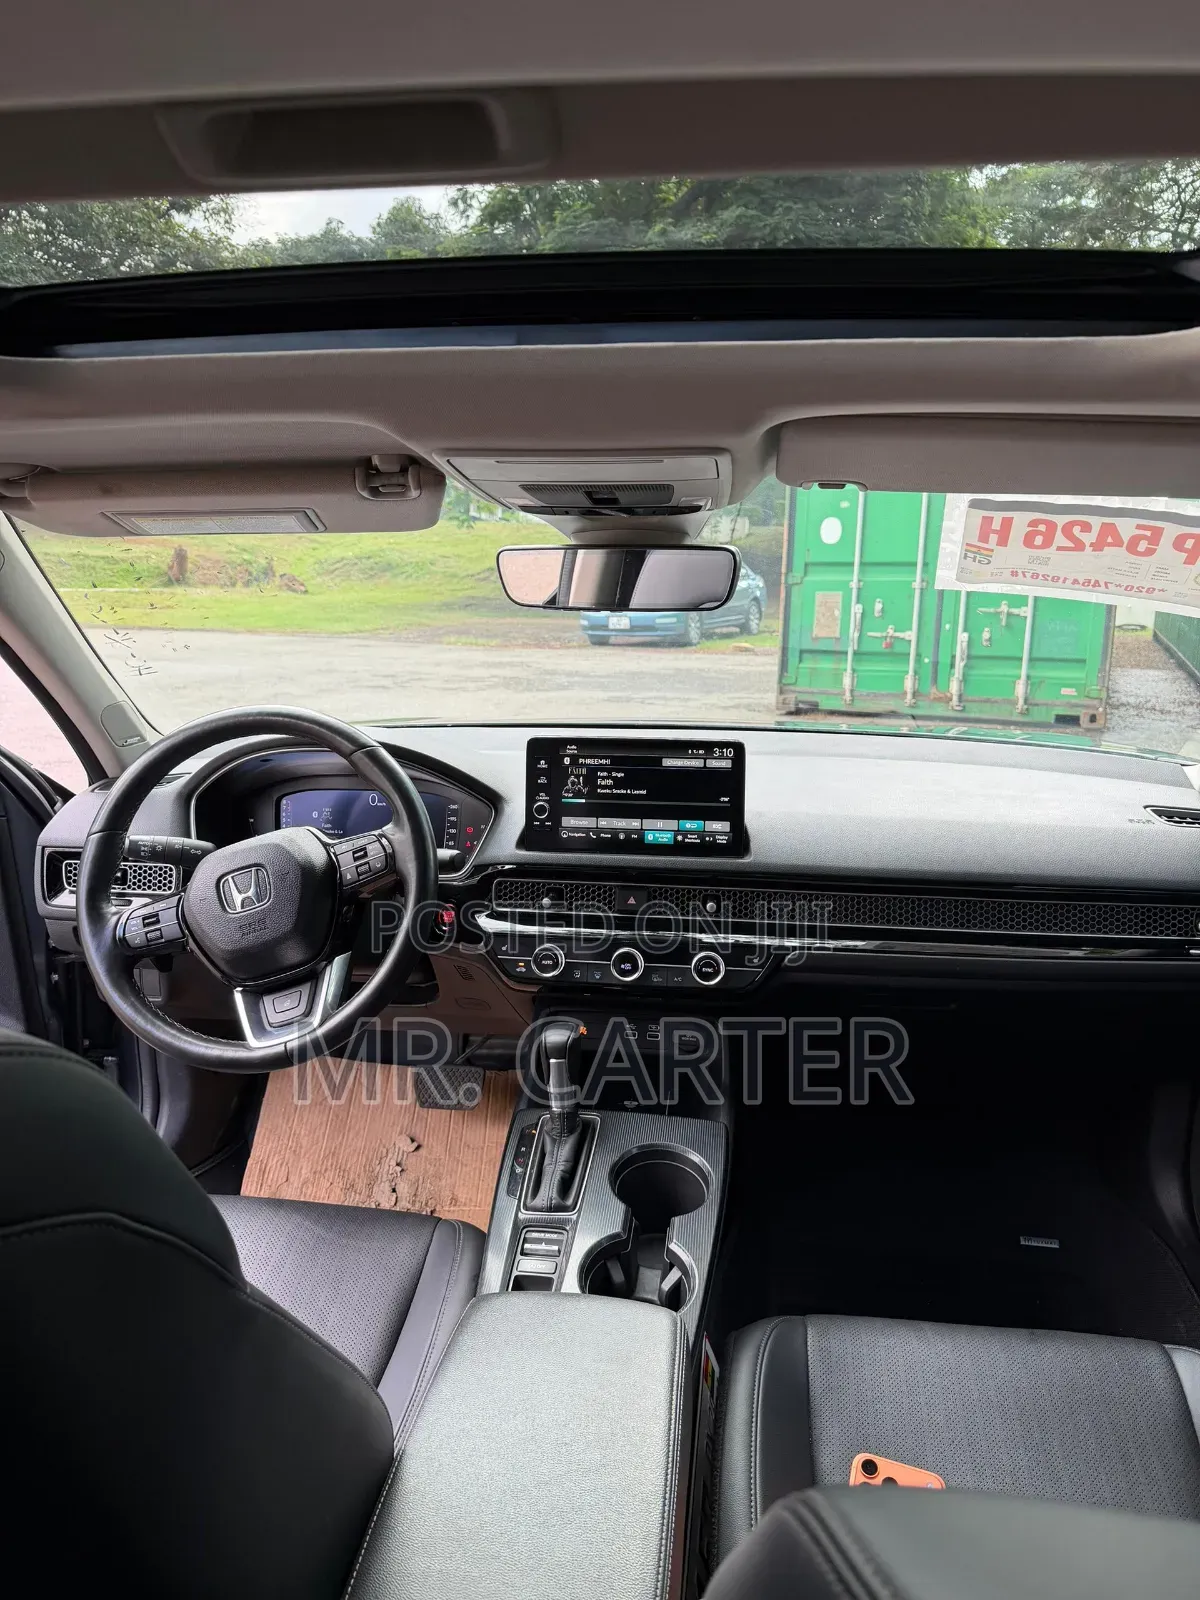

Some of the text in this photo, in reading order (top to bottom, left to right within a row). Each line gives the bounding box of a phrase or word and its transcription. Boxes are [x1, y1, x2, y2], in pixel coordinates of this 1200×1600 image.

[713, 747, 734, 757] 3:10
[597, 778, 614, 786] Faith
[369, 793, 378, 806] 0
